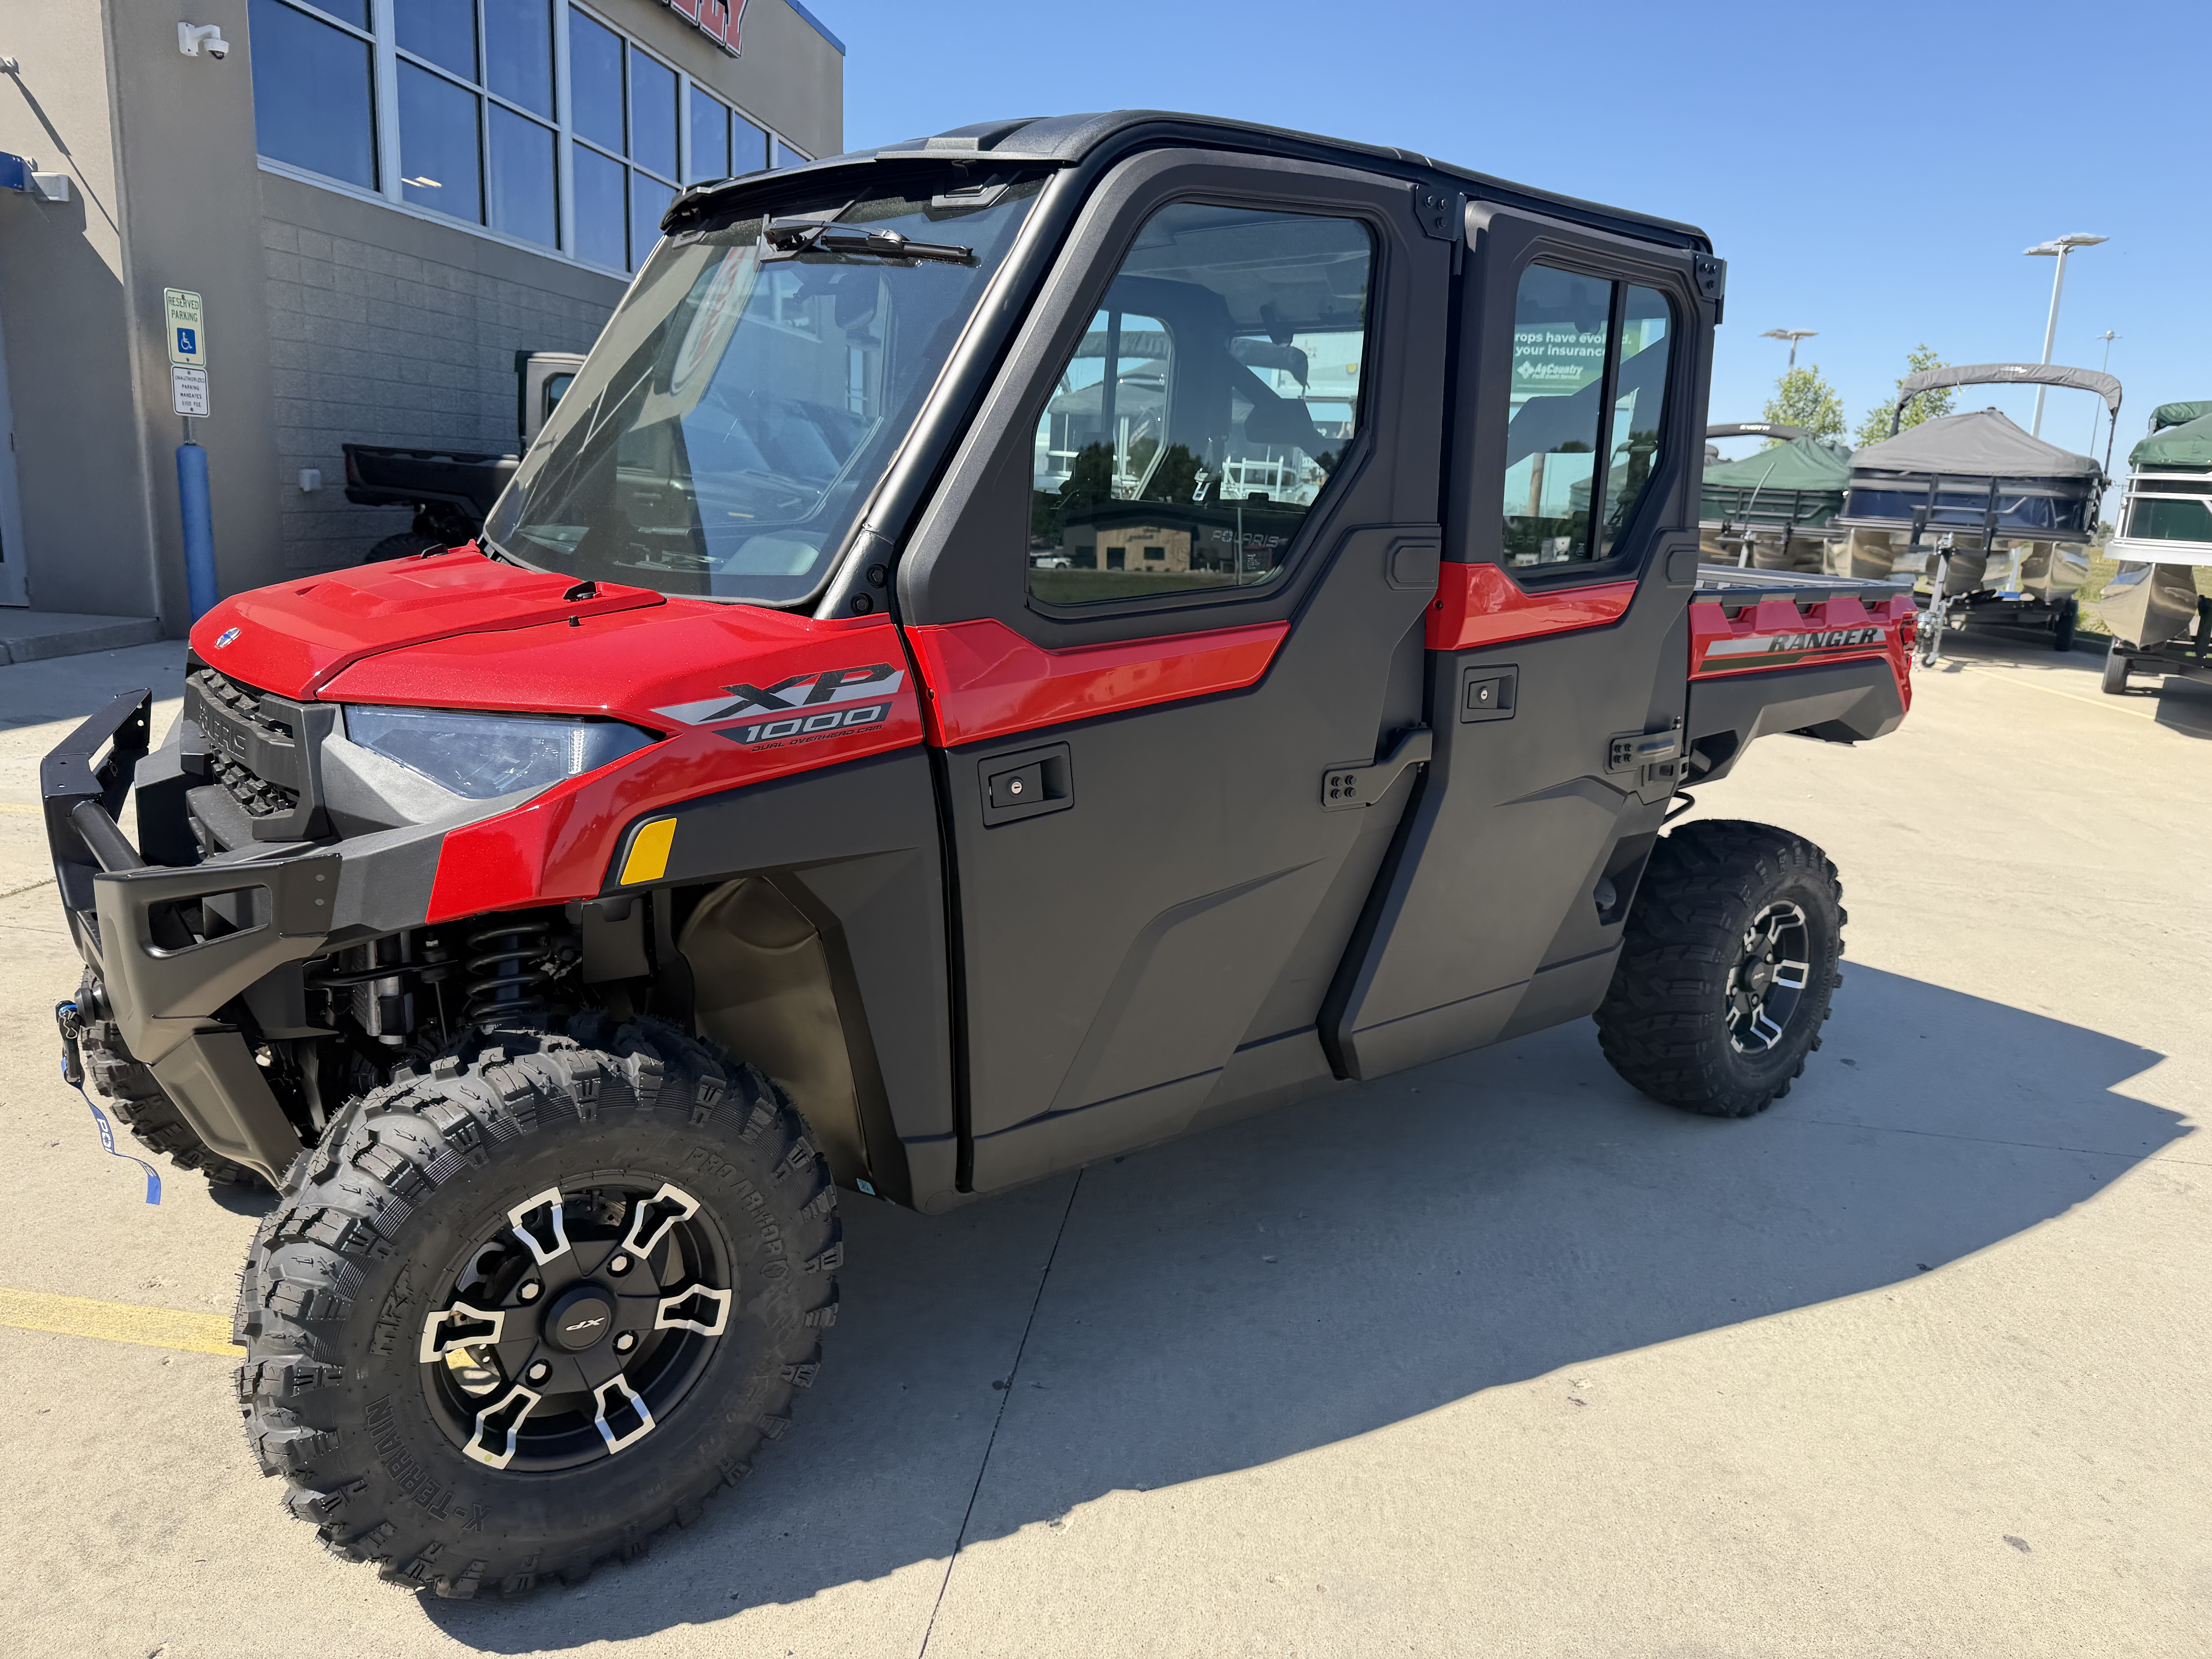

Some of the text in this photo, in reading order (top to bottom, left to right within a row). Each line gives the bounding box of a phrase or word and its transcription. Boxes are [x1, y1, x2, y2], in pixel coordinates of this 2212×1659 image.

[168, 296, 199, 310] RESERVED
[171, 309, 198, 322] PARKING
[1546, 331, 1576, 342] have
[1515, 346, 1545, 356] your
[1535, 363, 1583, 379] AgCountry
[1211, 529, 1279, 548] POLARIS
[1767, 628, 1878, 653] RANGER
[698, 663, 898, 722] XP
[746, 706, 882, 742] 1000
[751, 723, 883, 752] DUAL OVERHEAD CAM
[686, 1147, 783, 1256] PRO ARMOR
[366, 1395, 493, 1532] X-TERRAIN
